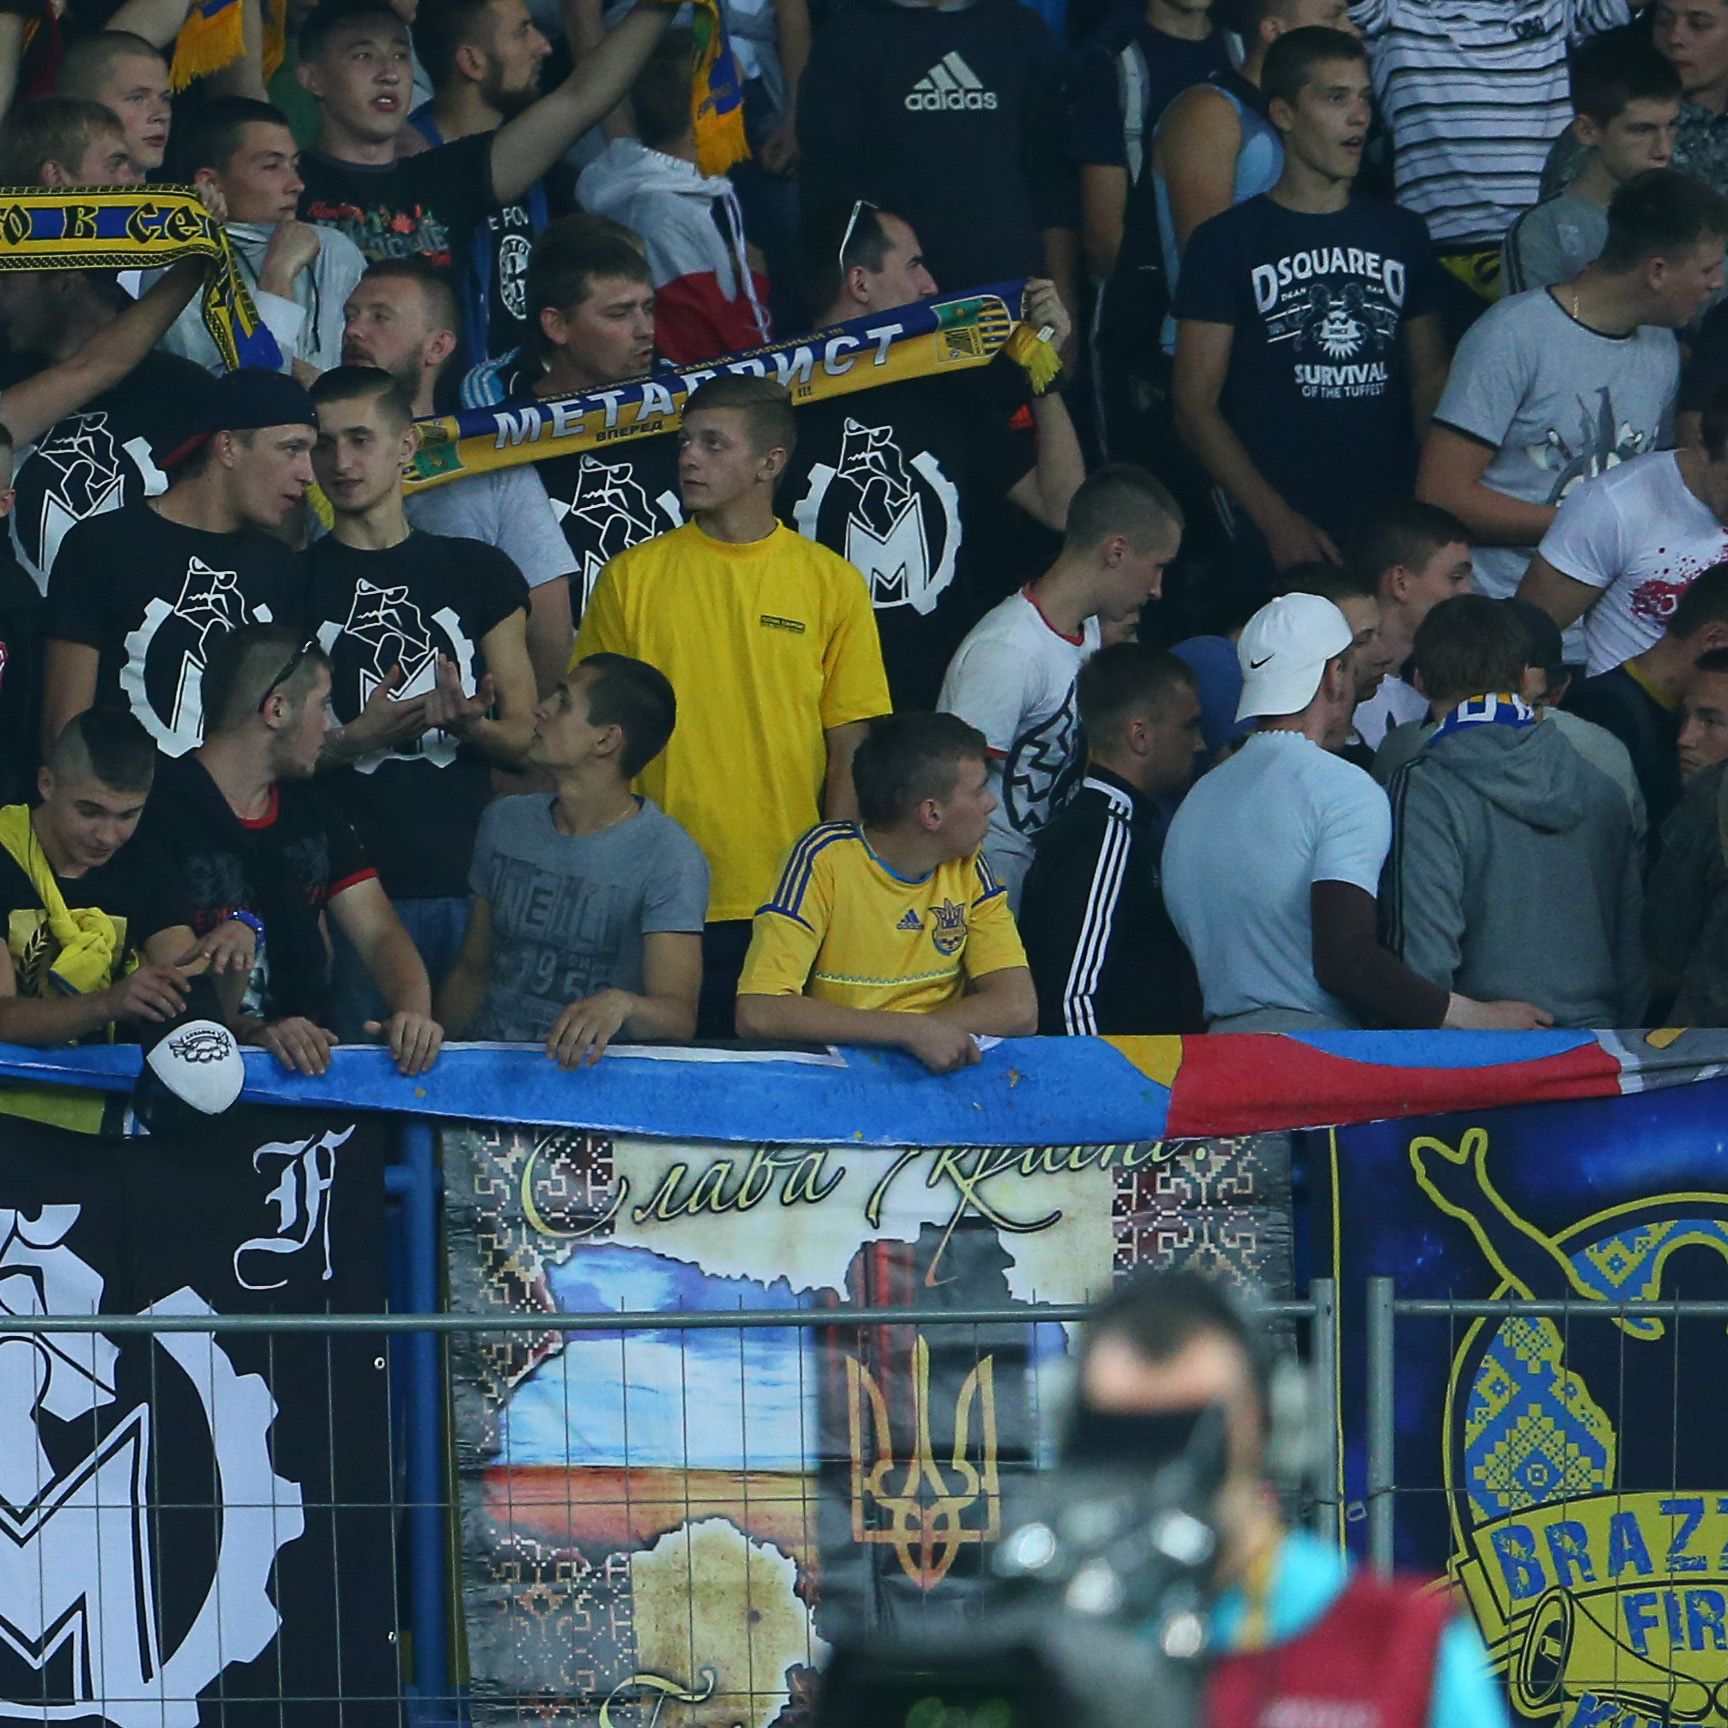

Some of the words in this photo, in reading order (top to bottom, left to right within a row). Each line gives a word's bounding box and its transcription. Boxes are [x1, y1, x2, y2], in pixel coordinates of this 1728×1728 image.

[904, 86, 998, 113] adidas
[1293, 361, 1389, 387] SURVIVAL
[1300, 383, 1318, 398] OF
[1320, 382, 1342, 398] THE
[595, 419, 664, 445] ВПЕРЕД
